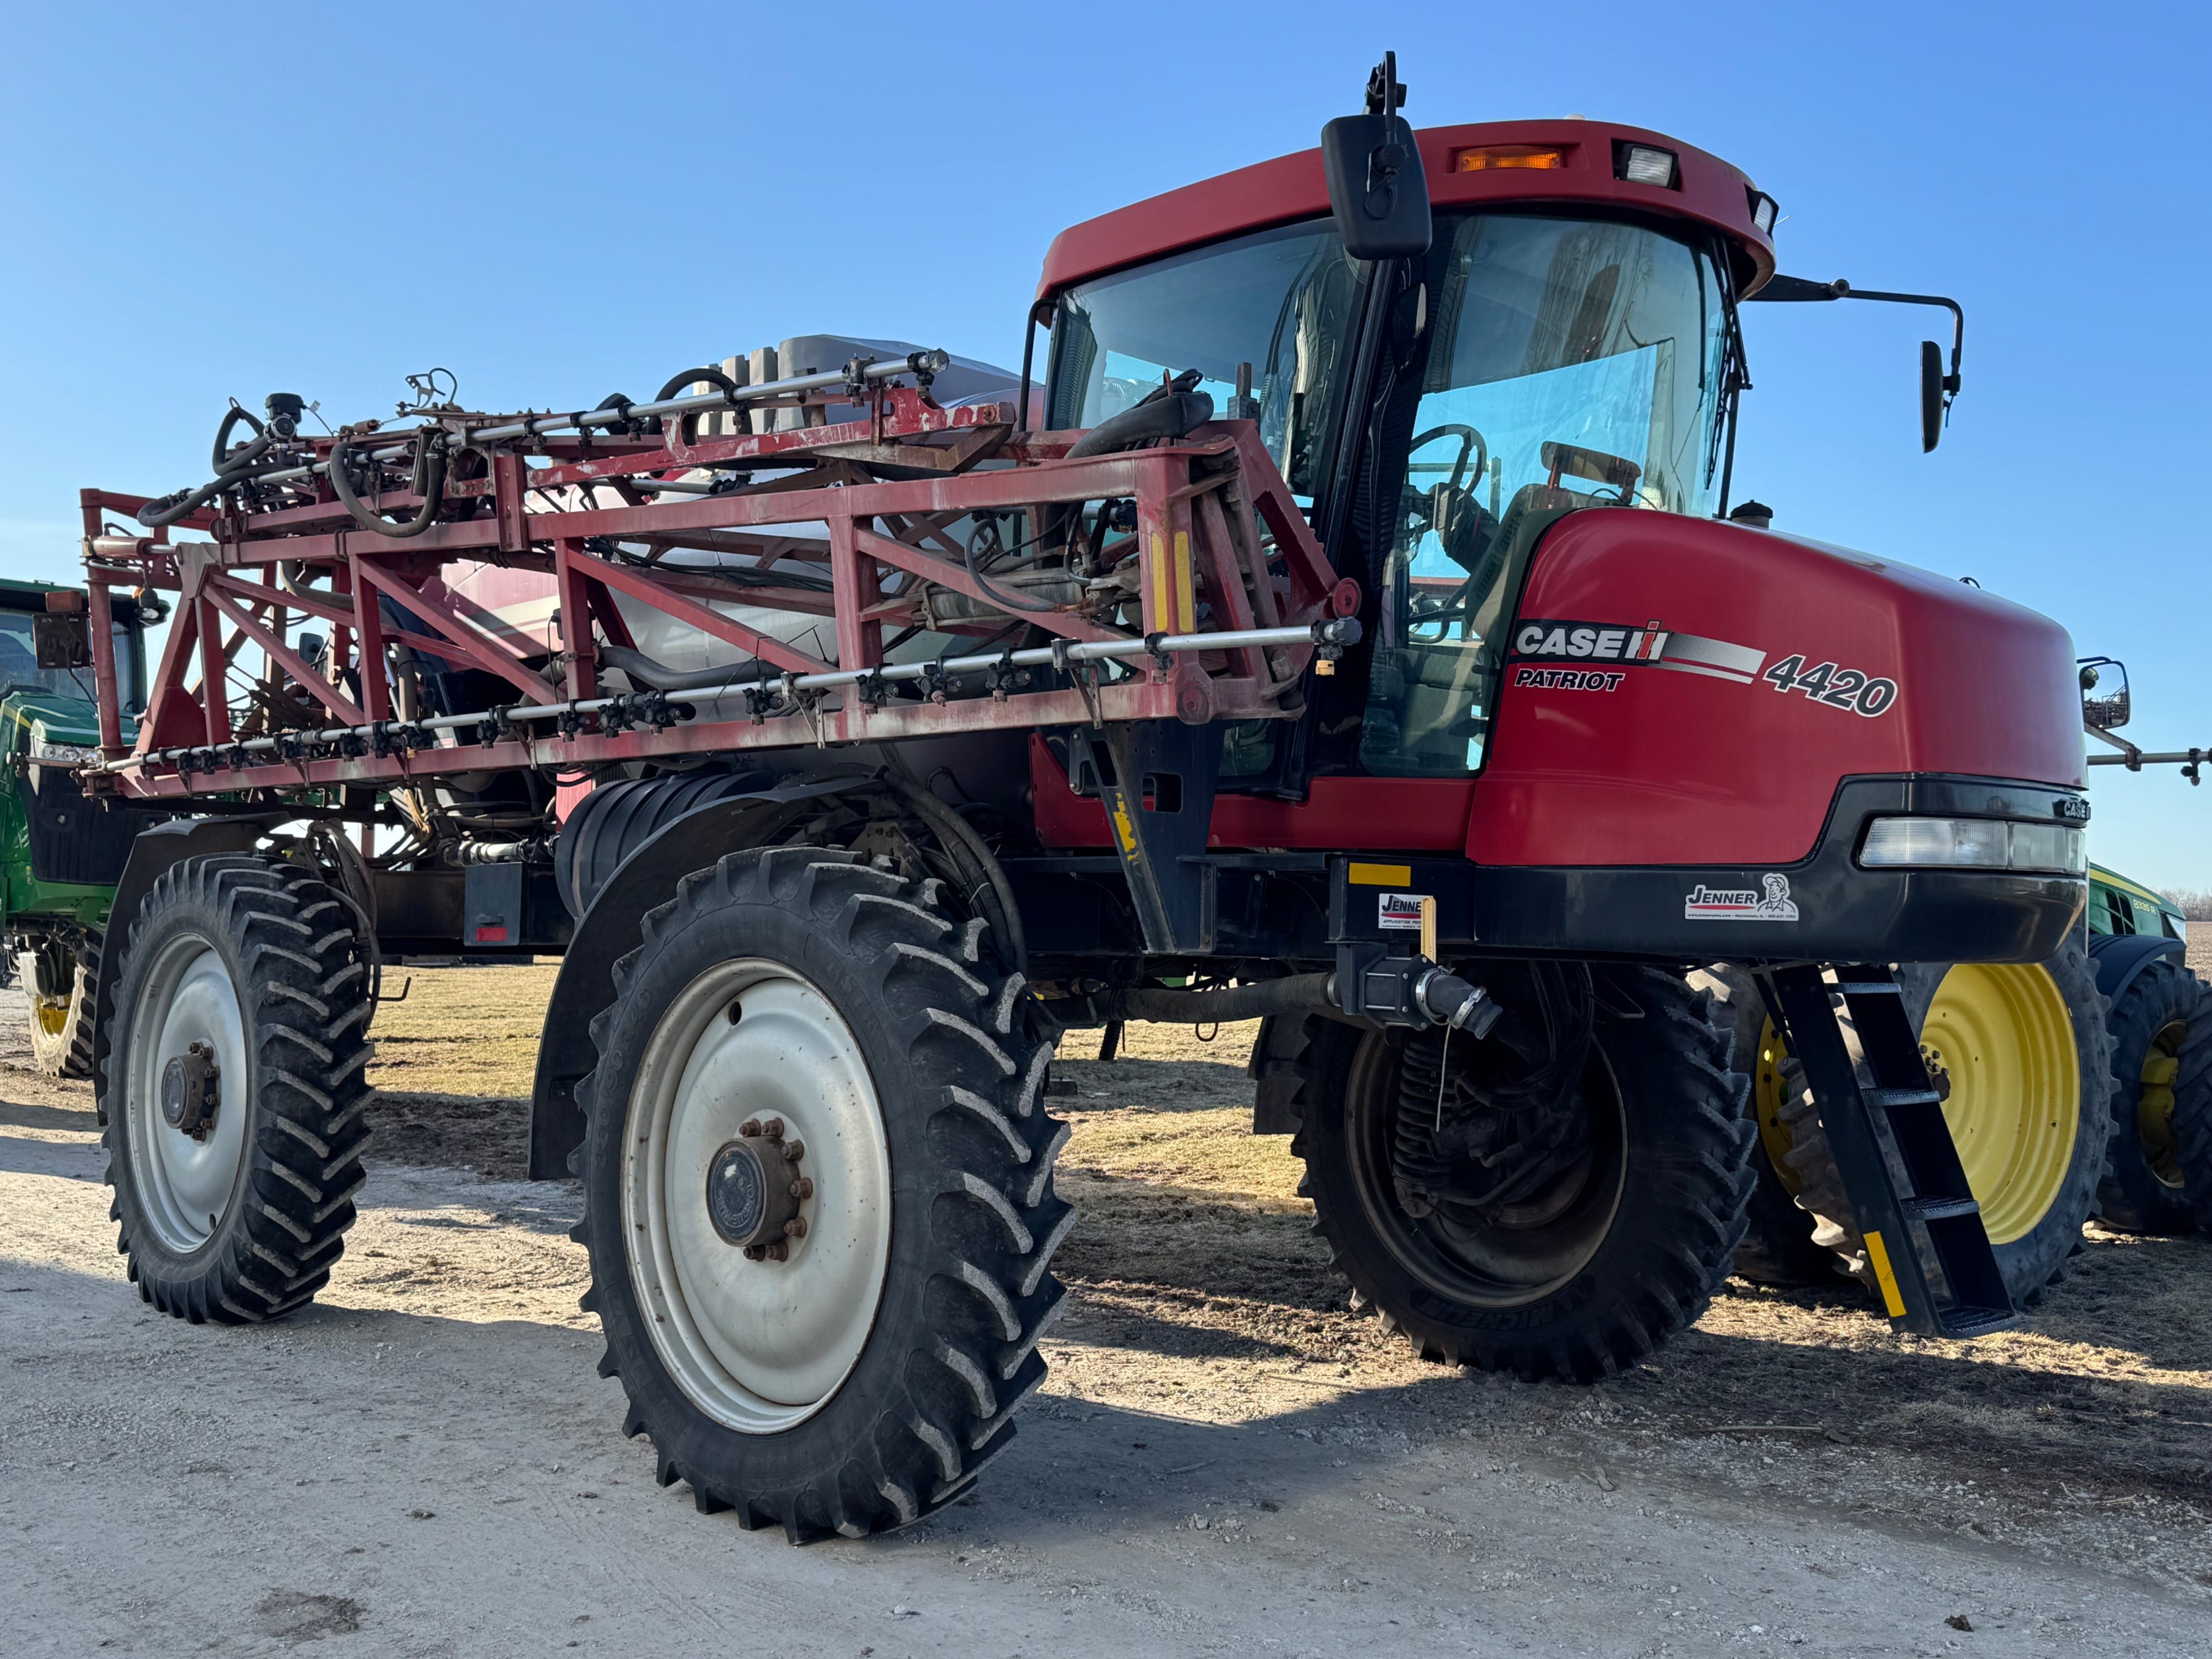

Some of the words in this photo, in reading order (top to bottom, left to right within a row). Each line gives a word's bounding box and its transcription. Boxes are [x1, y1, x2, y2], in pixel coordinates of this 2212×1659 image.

[1516, 625, 1626, 658] CASE
[1514, 668, 1626, 692] PATRIOT
[1762, 654, 1898, 718] 4420
[2064, 801, 2085, 819] CASE
[1382, 895, 1421, 912] JENNE
[1688, 887, 1755, 904] JENNER
[1415, 1291, 1554, 1331] MICHELIN
